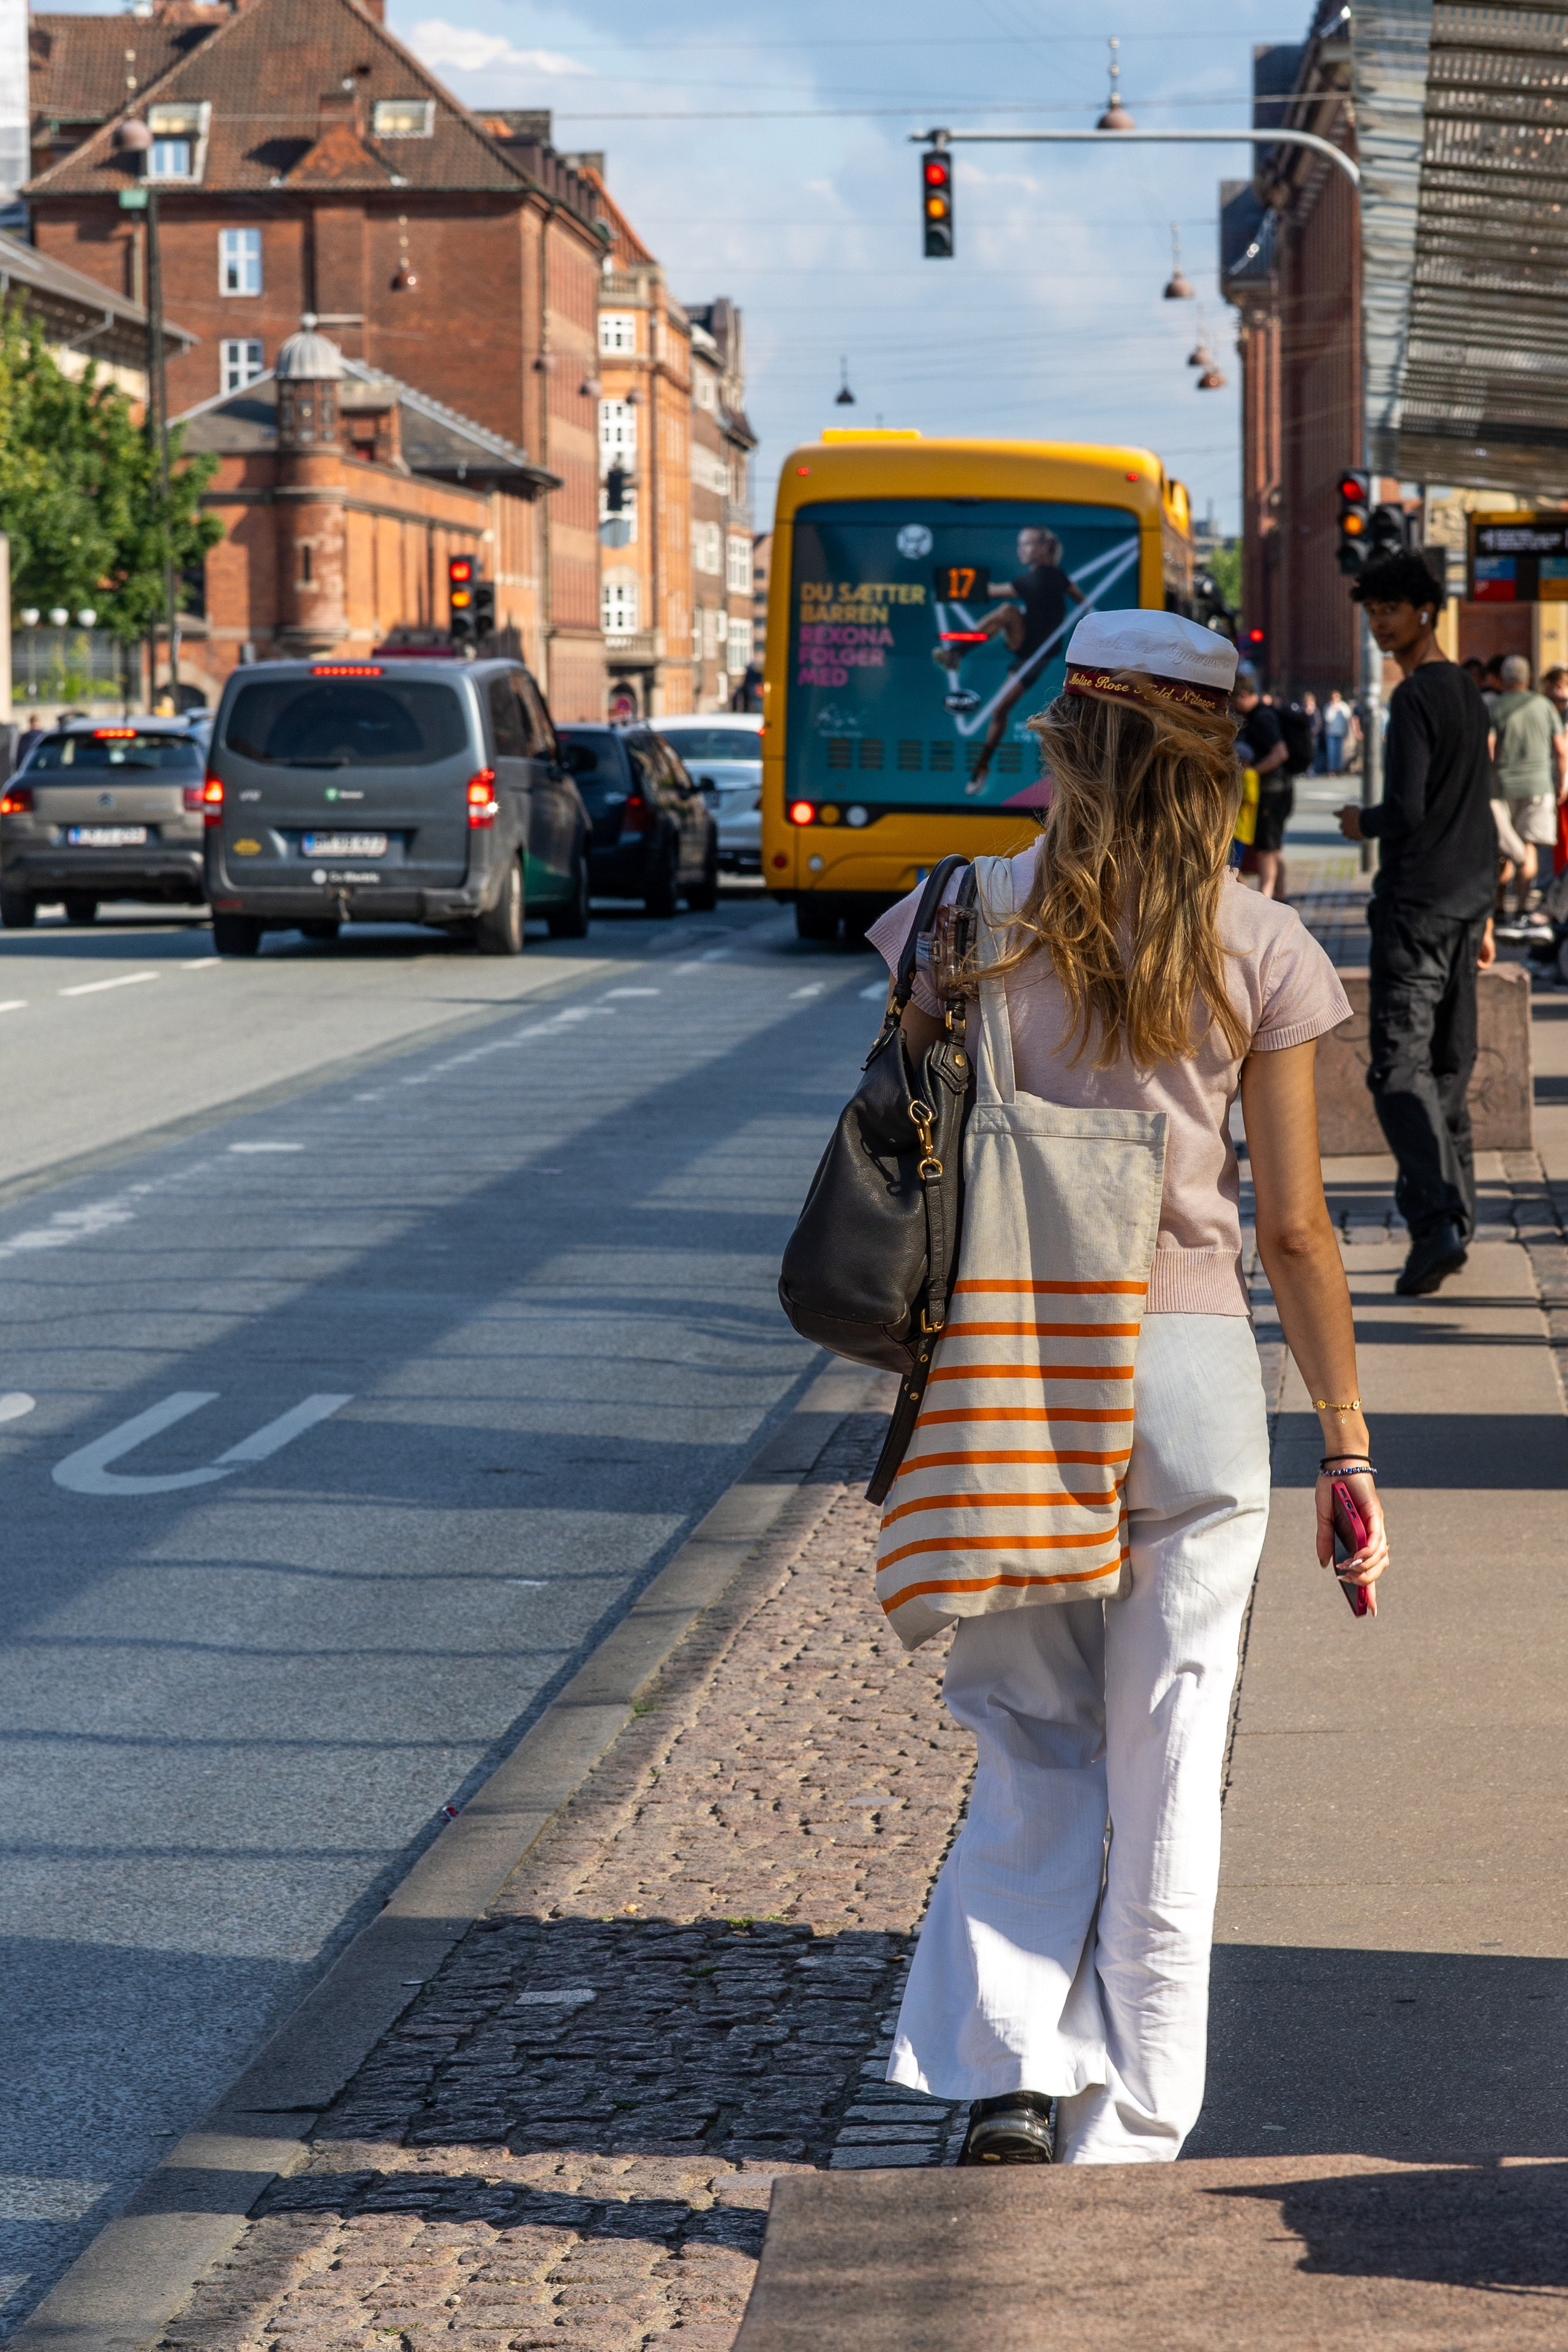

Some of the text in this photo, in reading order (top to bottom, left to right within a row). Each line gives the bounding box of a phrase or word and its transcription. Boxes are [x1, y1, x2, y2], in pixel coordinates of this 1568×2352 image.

[800, 581, 833, 603] DU
[948, 567, 976, 598] 17
[800, 603, 889, 624] BARREN
[799, 625, 895, 647] REXONA
[797, 667, 849, 687] MED
[1095, 676, 1129, 692] Rose
